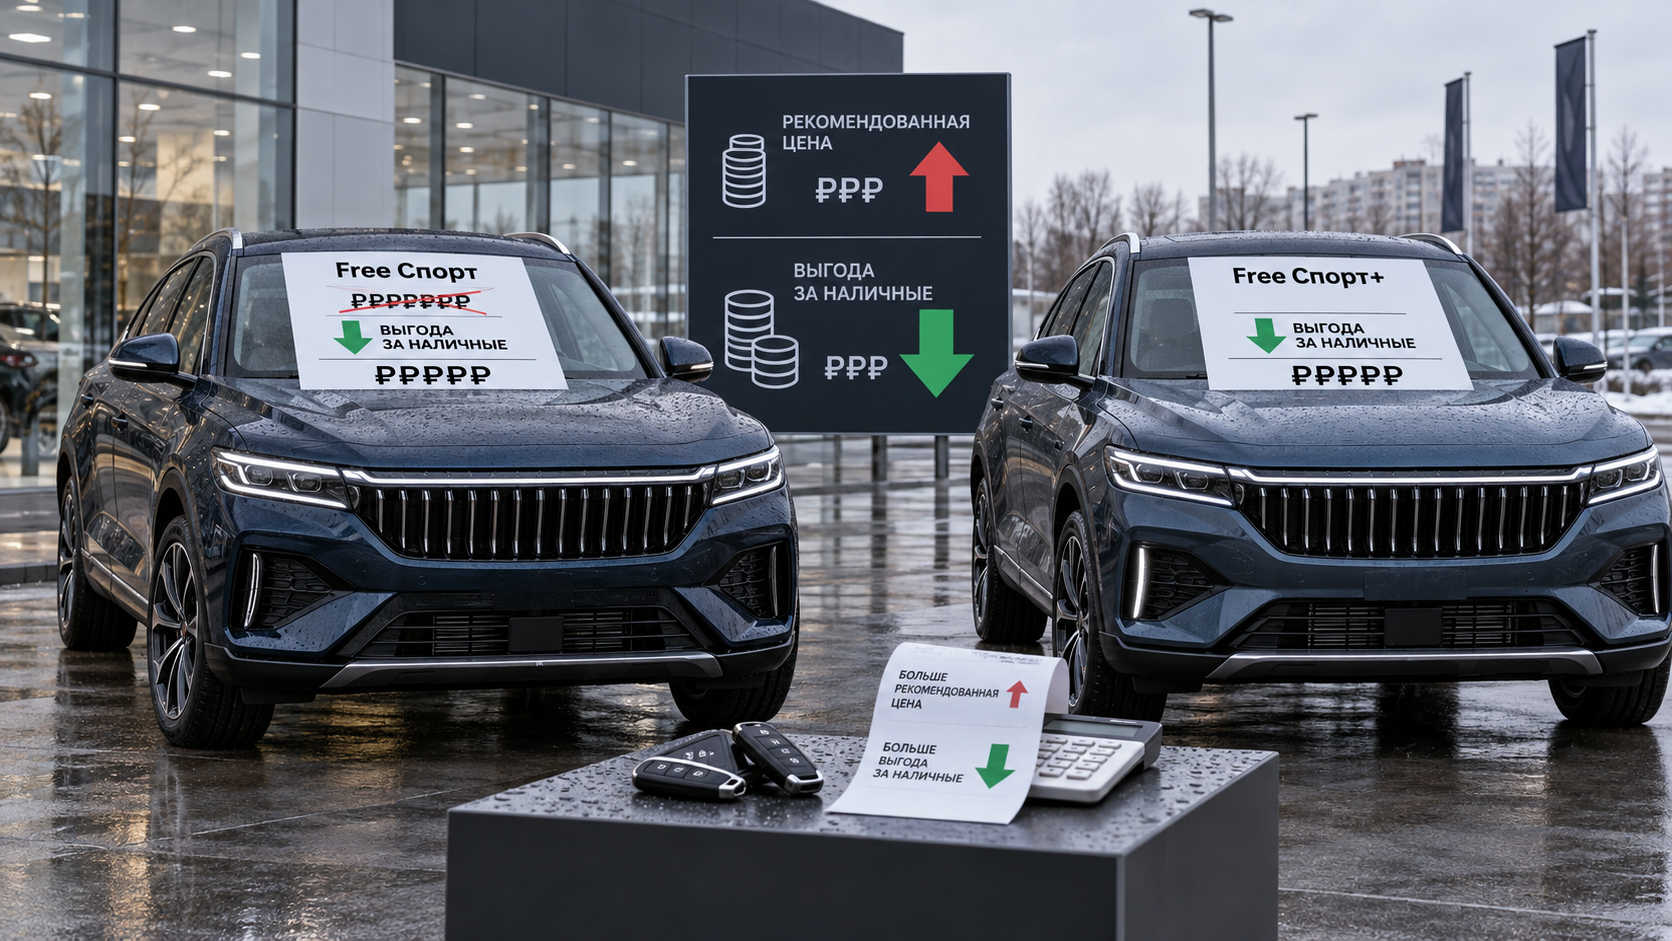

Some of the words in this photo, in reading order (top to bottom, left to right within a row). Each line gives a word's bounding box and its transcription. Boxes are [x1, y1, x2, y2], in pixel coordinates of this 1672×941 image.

[783, 115, 969, 131] РЕКОМЕНДОВАННАЯ
[783, 136, 832, 152] ЦЕНА
[336, 262, 390, 278] Free
[398, 263, 477, 283] Спорт
[795, 263, 874, 280] ВЫГОДА
[1233, 268, 1286, 284] Free
[1292, 268, 1384, 288] Спорт+
[794, 286, 818, 300] ЗА
[825, 286, 932, 300] НАЛИЧНЫЕ
[380, 325, 454, 337] ВЫГОДА
[1293, 323, 1364, 335] ВЫГОДА
[383, 339, 404, 349] ЗА
[409, 339, 507, 349] НАЛИЧНЫЕ
[1296, 338, 1317, 348] ЗА
[1321, 338, 1416, 348] НАЛИЧНЫЕ
[899, 670, 947, 681] БОЛЬШЕ
[895, 684, 999, 698] РЕКОМЕНДОВАННАЯ
[891, 699, 921, 709] ЦЕНА
[883, 742, 936, 754] БОЛЬШЕ
[879, 756, 927, 768] ВЫГОДА
[873, 769, 888, 777] ЗА
[893, 771, 963, 782] НАЛИЧНЫЕ
